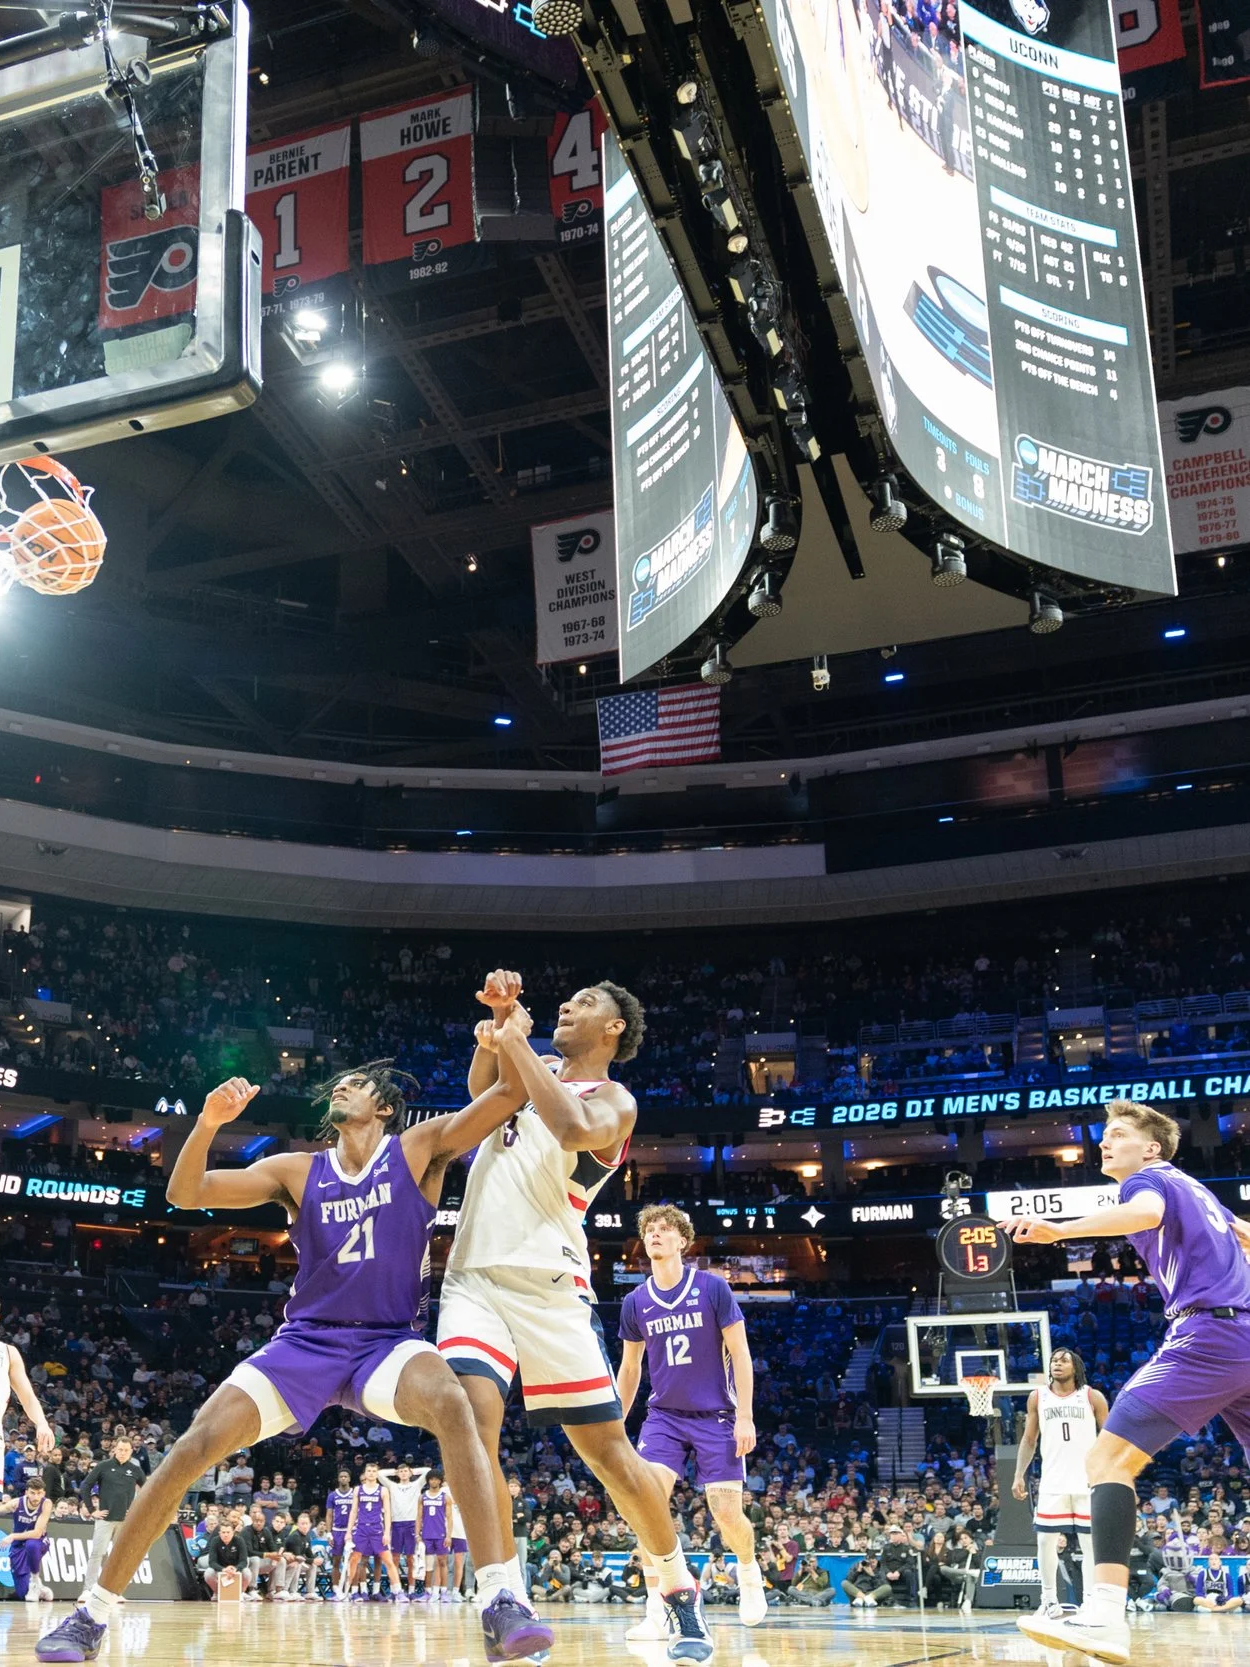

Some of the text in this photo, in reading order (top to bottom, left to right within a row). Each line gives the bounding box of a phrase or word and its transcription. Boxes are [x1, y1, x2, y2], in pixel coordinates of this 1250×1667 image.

[1010, 37, 1059, 69] UCONN
[410, 107, 441, 125] MARK
[399, 116, 452, 146] HOWE
[269, 145, 305, 164] BERNIE
[553, 110, 599, 192] 4
[253, 152, 322, 187] PARENT
[404, 154, 449, 235] 2
[1026, 207, 1076, 232] TEAM STATS
[274, 193, 299, 269] 1
[560, 222, 599, 242] 1970-74
[409, 262, 448, 280] 1982-92
[290, 292, 325, 310] 1973-79
[1014, 319, 1030, 334] PTS
[1041, 308, 1080, 329] SCORING
[1032, 345, 1063, 367] CHANCE
[1064, 357, 1096, 376] POINTS
[1021, 360, 1037, 376] PTS
[1070, 377, 1098, 396] BENCH
[965, 450, 990, 476] FOULS
[1038, 447, 1111, 491] MARCH
[1173, 448, 1246, 471] CAMPBELL
[1048, 476, 1150, 524] MADNESS
[565, 569, 596, 585] WEST
[557, 579, 606, 599] DIVISION
[548, 589, 615, 612] CHAMPIONS
[562, 616, 605, 634] 1967-68
[564, 629, 605, 647] 1973-74
[832, 1103, 898, 1123] 2026
[905, 1099, 935, 1117] DI
[943, 1092, 1020, 1115] MEN'S
[1028, 1079, 1199, 1108] BASKETBALL
[26, 1178, 121, 1205] ROUNDS
[321, 1182, 392, 1224] FURMAN
[716, 1208, 738, 1216] BONUS
[764, 1207, 776, 1215] TOL
[851, 1204, 914, 1223] FURMAN
[1010, 1195, 1063, 1216] 2:05
[595, 1214, 622, 1228] 39.1
[747, 1216, 774, 1228] 7 1
[337, 1216, 375, 1264] 21
[959, 1227, 996, 1244] 2:05
[646, 1312, 704, 1337] FURMAN
[665, 1334, 693, 1367] 12
[1044, 1403, 1085, 1421] CONNECTICUT
[1062, 1422, 1070, 1441] 0
[341, 1505, 348, 1515] 2
[366, 1502, 372, 1511] 4
[997, 1558, 1033, 1570] MARCH
[1002, 1569, 1039, 1581] MADNE
